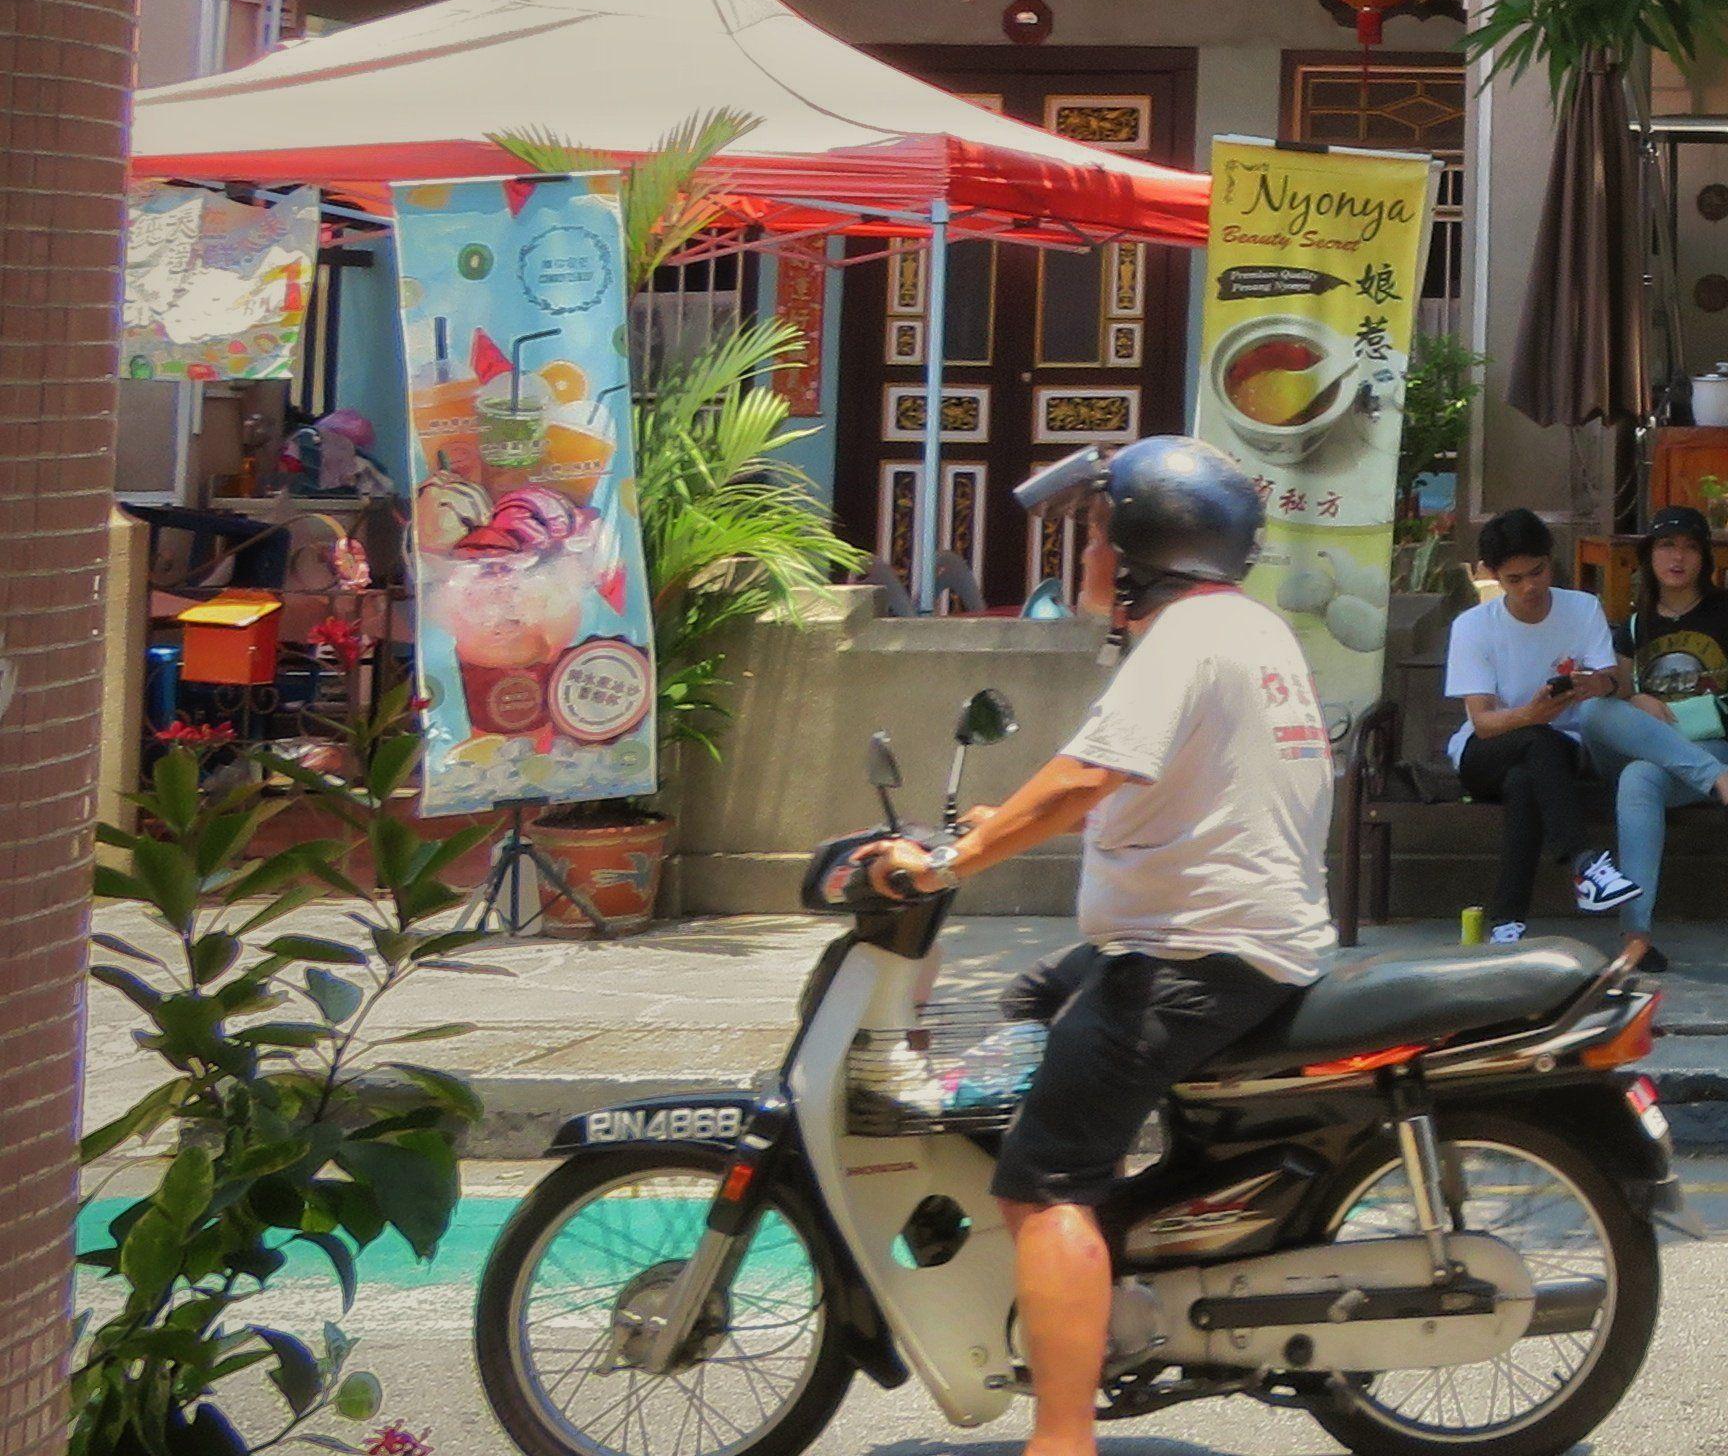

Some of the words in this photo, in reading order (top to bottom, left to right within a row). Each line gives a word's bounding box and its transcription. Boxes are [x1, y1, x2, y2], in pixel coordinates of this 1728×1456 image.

[1240, 173, 1417, 242] Nyonya
[1222, 225, 1292, 250] Beauty
[1299, 229, 1363, 253] Secret
